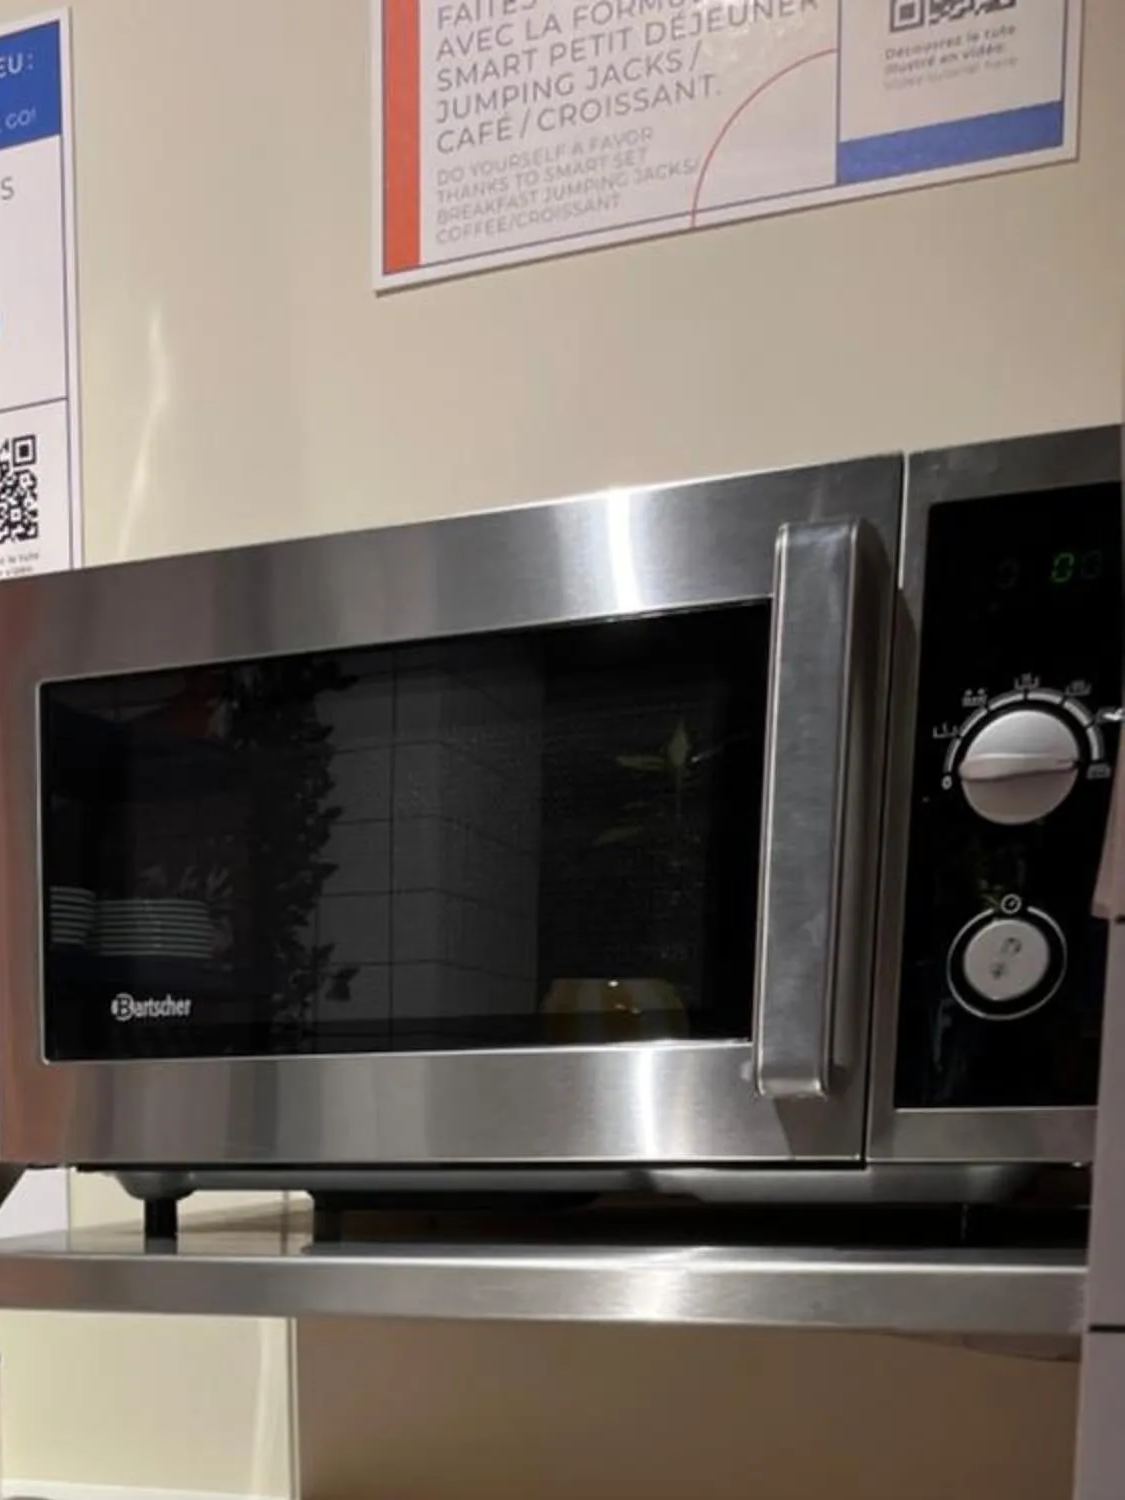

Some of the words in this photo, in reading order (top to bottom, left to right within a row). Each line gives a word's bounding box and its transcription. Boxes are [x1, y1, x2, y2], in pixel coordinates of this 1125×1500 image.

[436, 22, 514, 61] AVEC
[526, 12, 563, 41] LA
[437, 48, 538, 92] SMART
[550, 26, 633, 67] PETIT
[436, 69, 575, 124] JUMPING
[586, 50, 683, 90] JACKS
[436, 116, 512, 155] CAFÉ
[537, 72, 722, 132] CROISSANT.
[436, 166, 464, 187] DO
[471, 143, 567, 178] YOURSELF
[571, 140, 585, 156] A
[589, 126, 654, 152] FAVOR
[436, 176, 510, 204] THANKS
[516, 167, 540, 187] TO
[544, 157, 612, 183] SMART
[615, 147, 650, 168] SET
[437, 188, 537, 225] BREAKFAST
[543, 172, 628, 204] JUMPING
